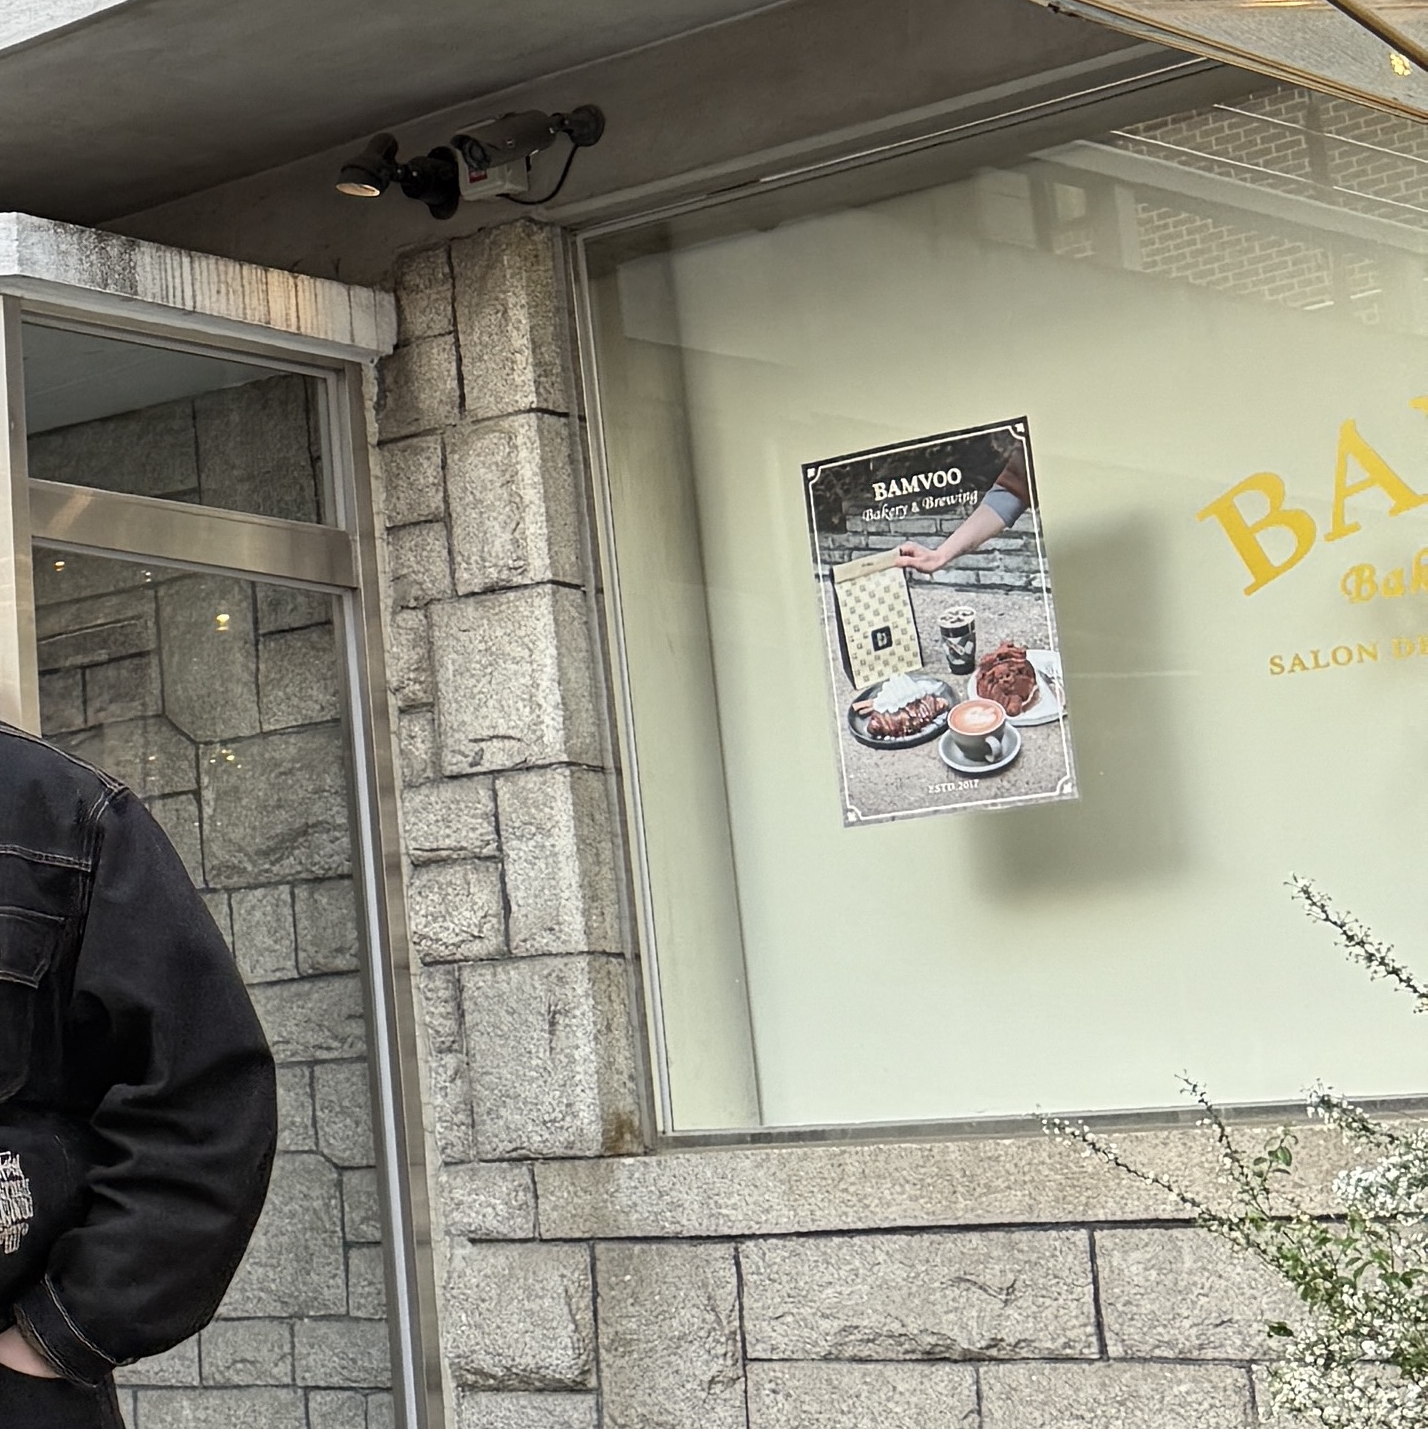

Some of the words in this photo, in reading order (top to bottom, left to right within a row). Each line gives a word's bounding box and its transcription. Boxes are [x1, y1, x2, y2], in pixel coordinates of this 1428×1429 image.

[872, 468, 963, 501] BAMVOO
[1195, 395, 1428, 597] BA
[862, 503, 908, 522] Bakery
[922, 489, 978, 510] Brewing
[1268, 642, 1379, 676] SALON
